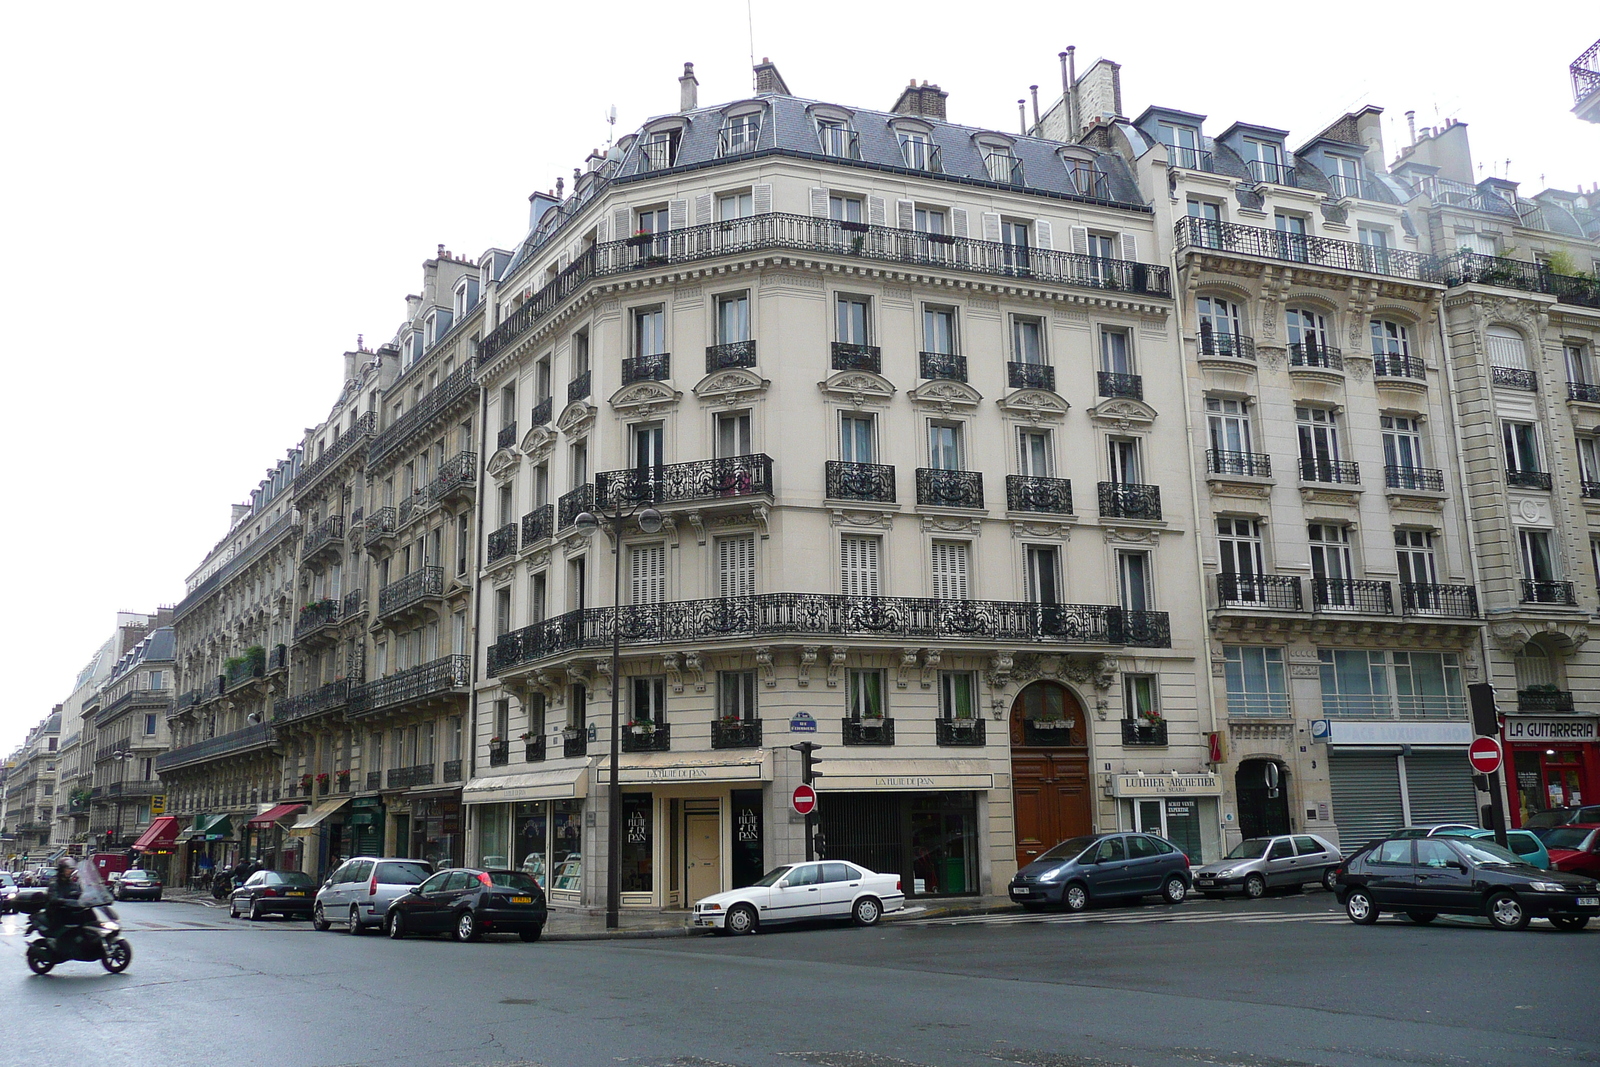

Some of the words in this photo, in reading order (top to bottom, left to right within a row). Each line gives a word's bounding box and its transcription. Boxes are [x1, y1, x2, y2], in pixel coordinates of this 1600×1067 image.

[1509, 722, 1523, 737] LA
[1527, 722, 1593, 737] GUITARRERIA
[1311, 760, 1317, 769] 3
[917, 778, 934, 786] PAN
[1125, 778, 1164, 788] LUTHIER
[631, 811, 643, 819] LA
[742, 808, 754, 816] LA
[628, 833, 646, 843] PAN
[739, 831, 758, 841] PAN
